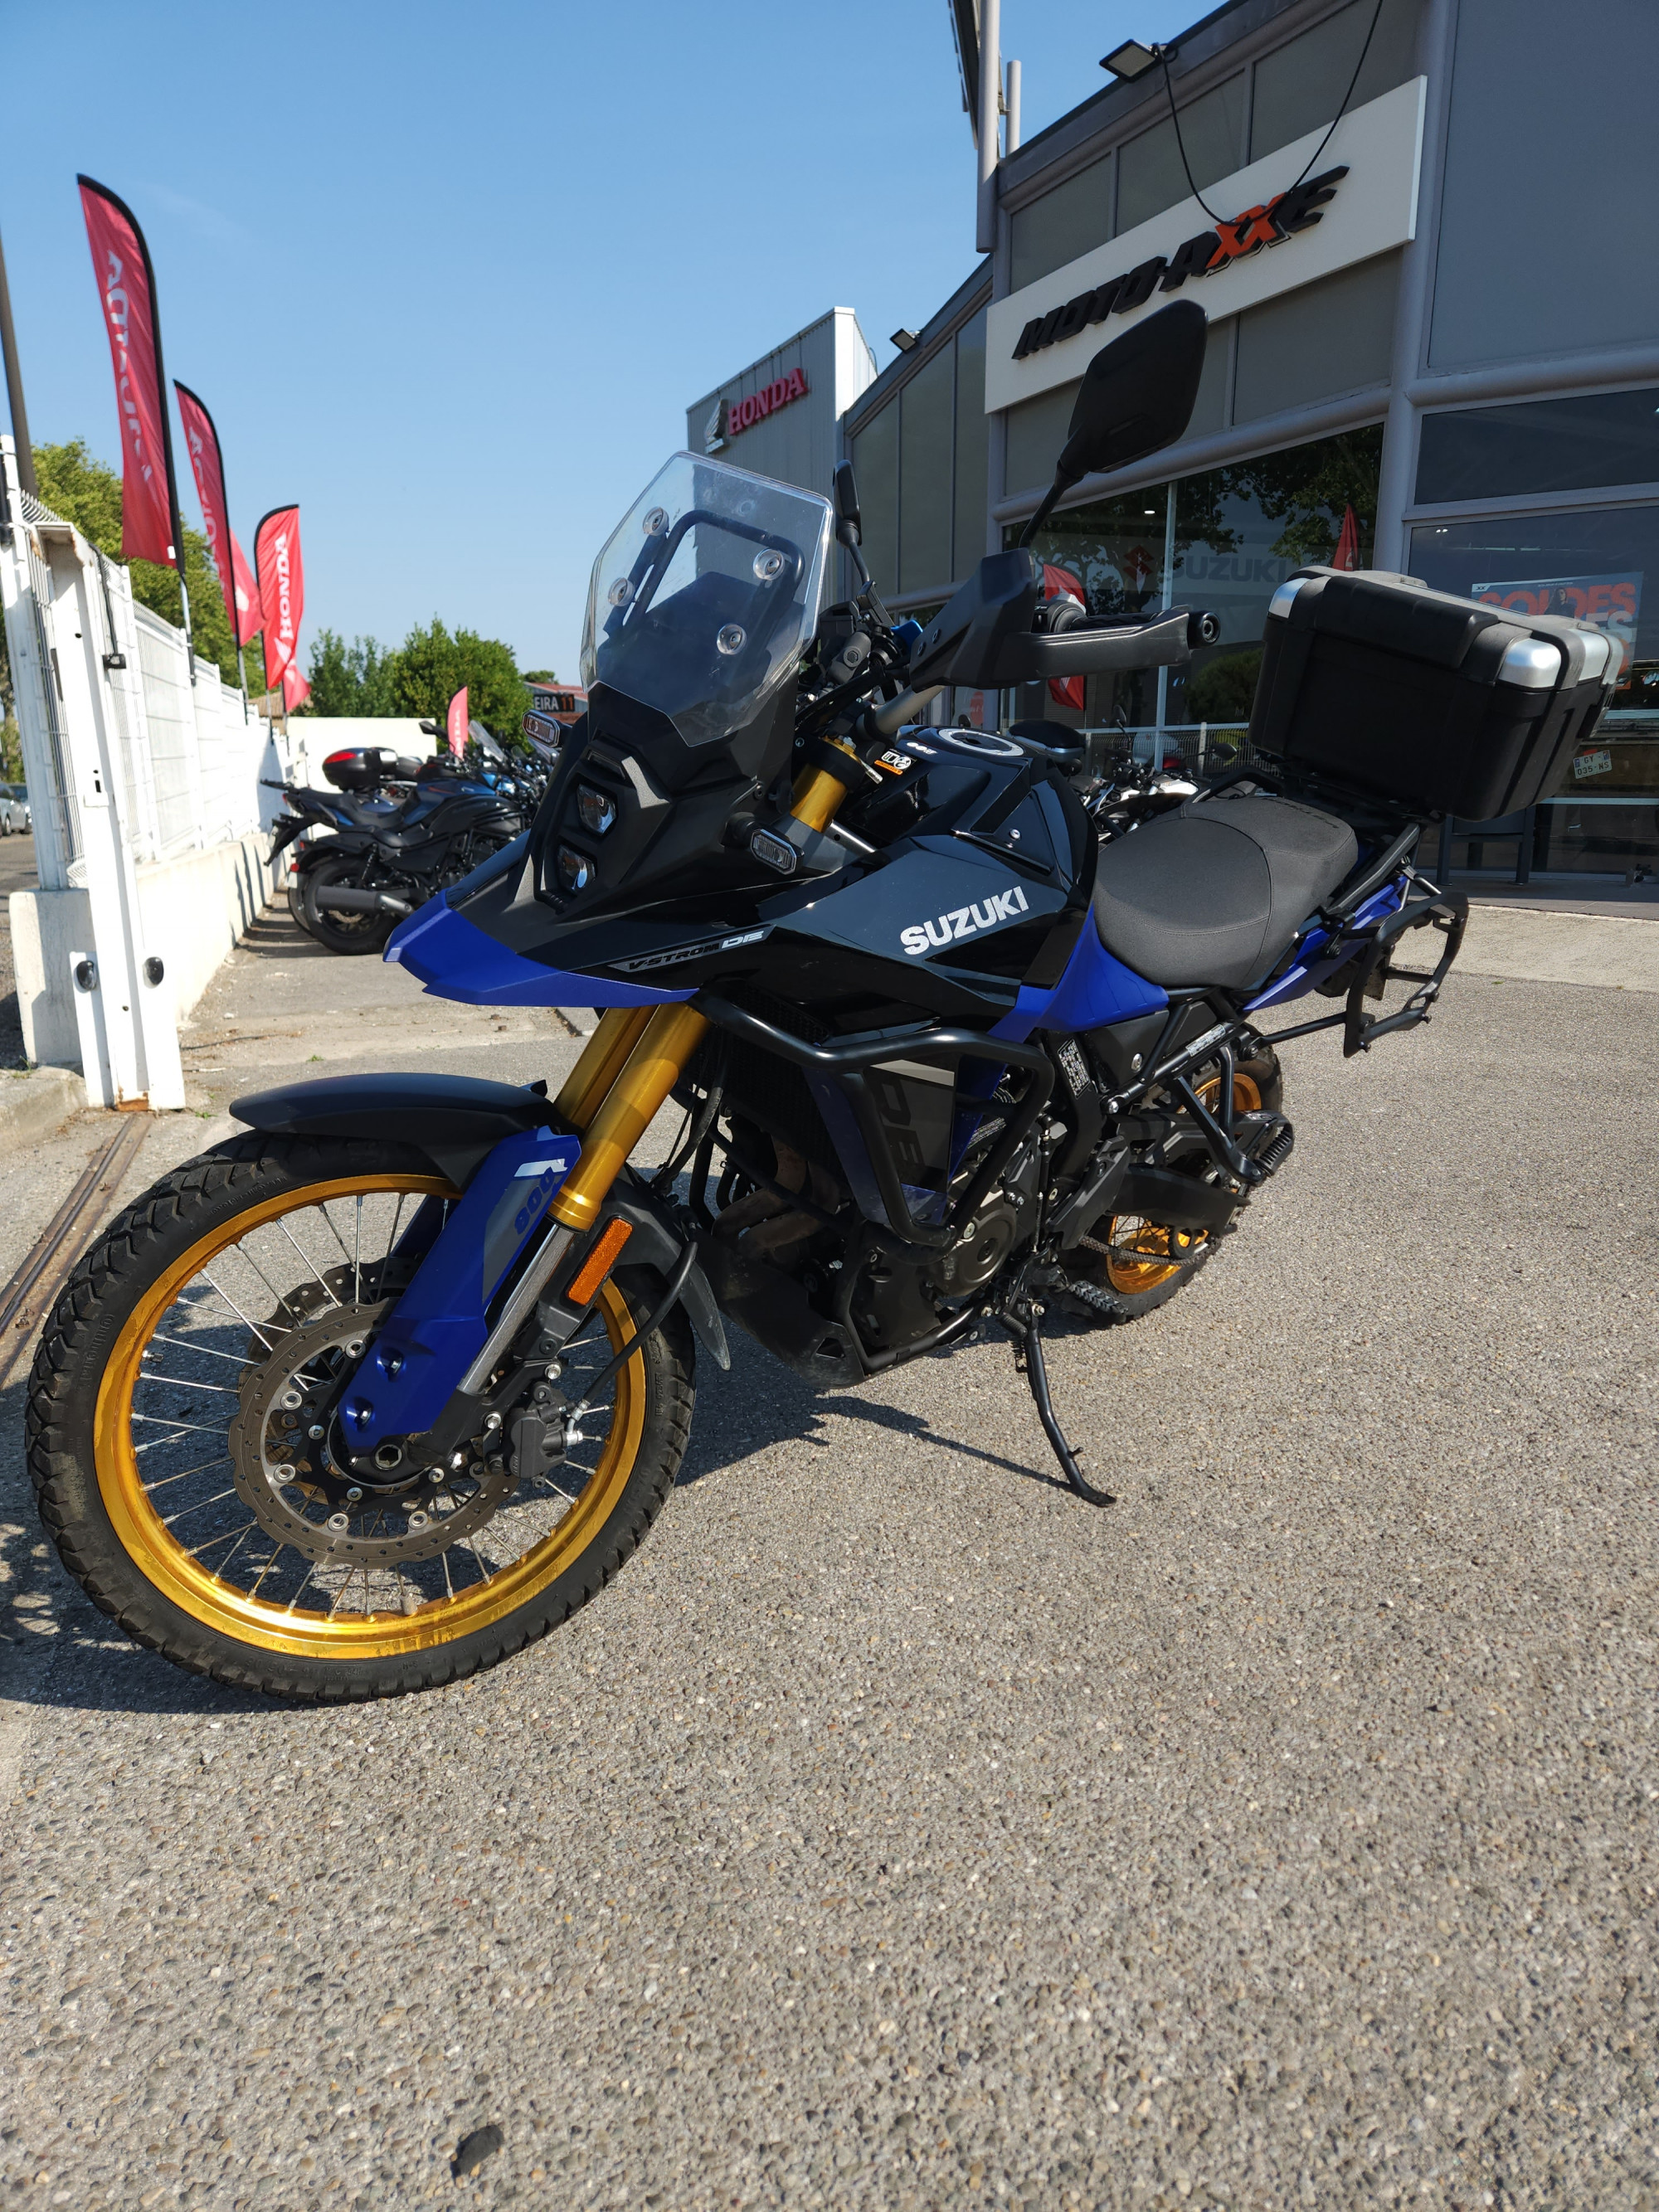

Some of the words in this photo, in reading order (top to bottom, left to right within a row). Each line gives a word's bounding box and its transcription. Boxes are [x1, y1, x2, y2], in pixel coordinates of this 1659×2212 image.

[1011, 165, 1350, 360] MOTO-AXXE
[727, 367, 809, 436] HONDA
[275, 532, 293, 639] HONDA
[561, 696, 573, 711] 11
[628, 942, 720, 970] V-STROM
[721, 930, 765, 950] DE
[900, 886, 1029, 955] SUZUKI
[514, 1166, 555, 1235] 800
